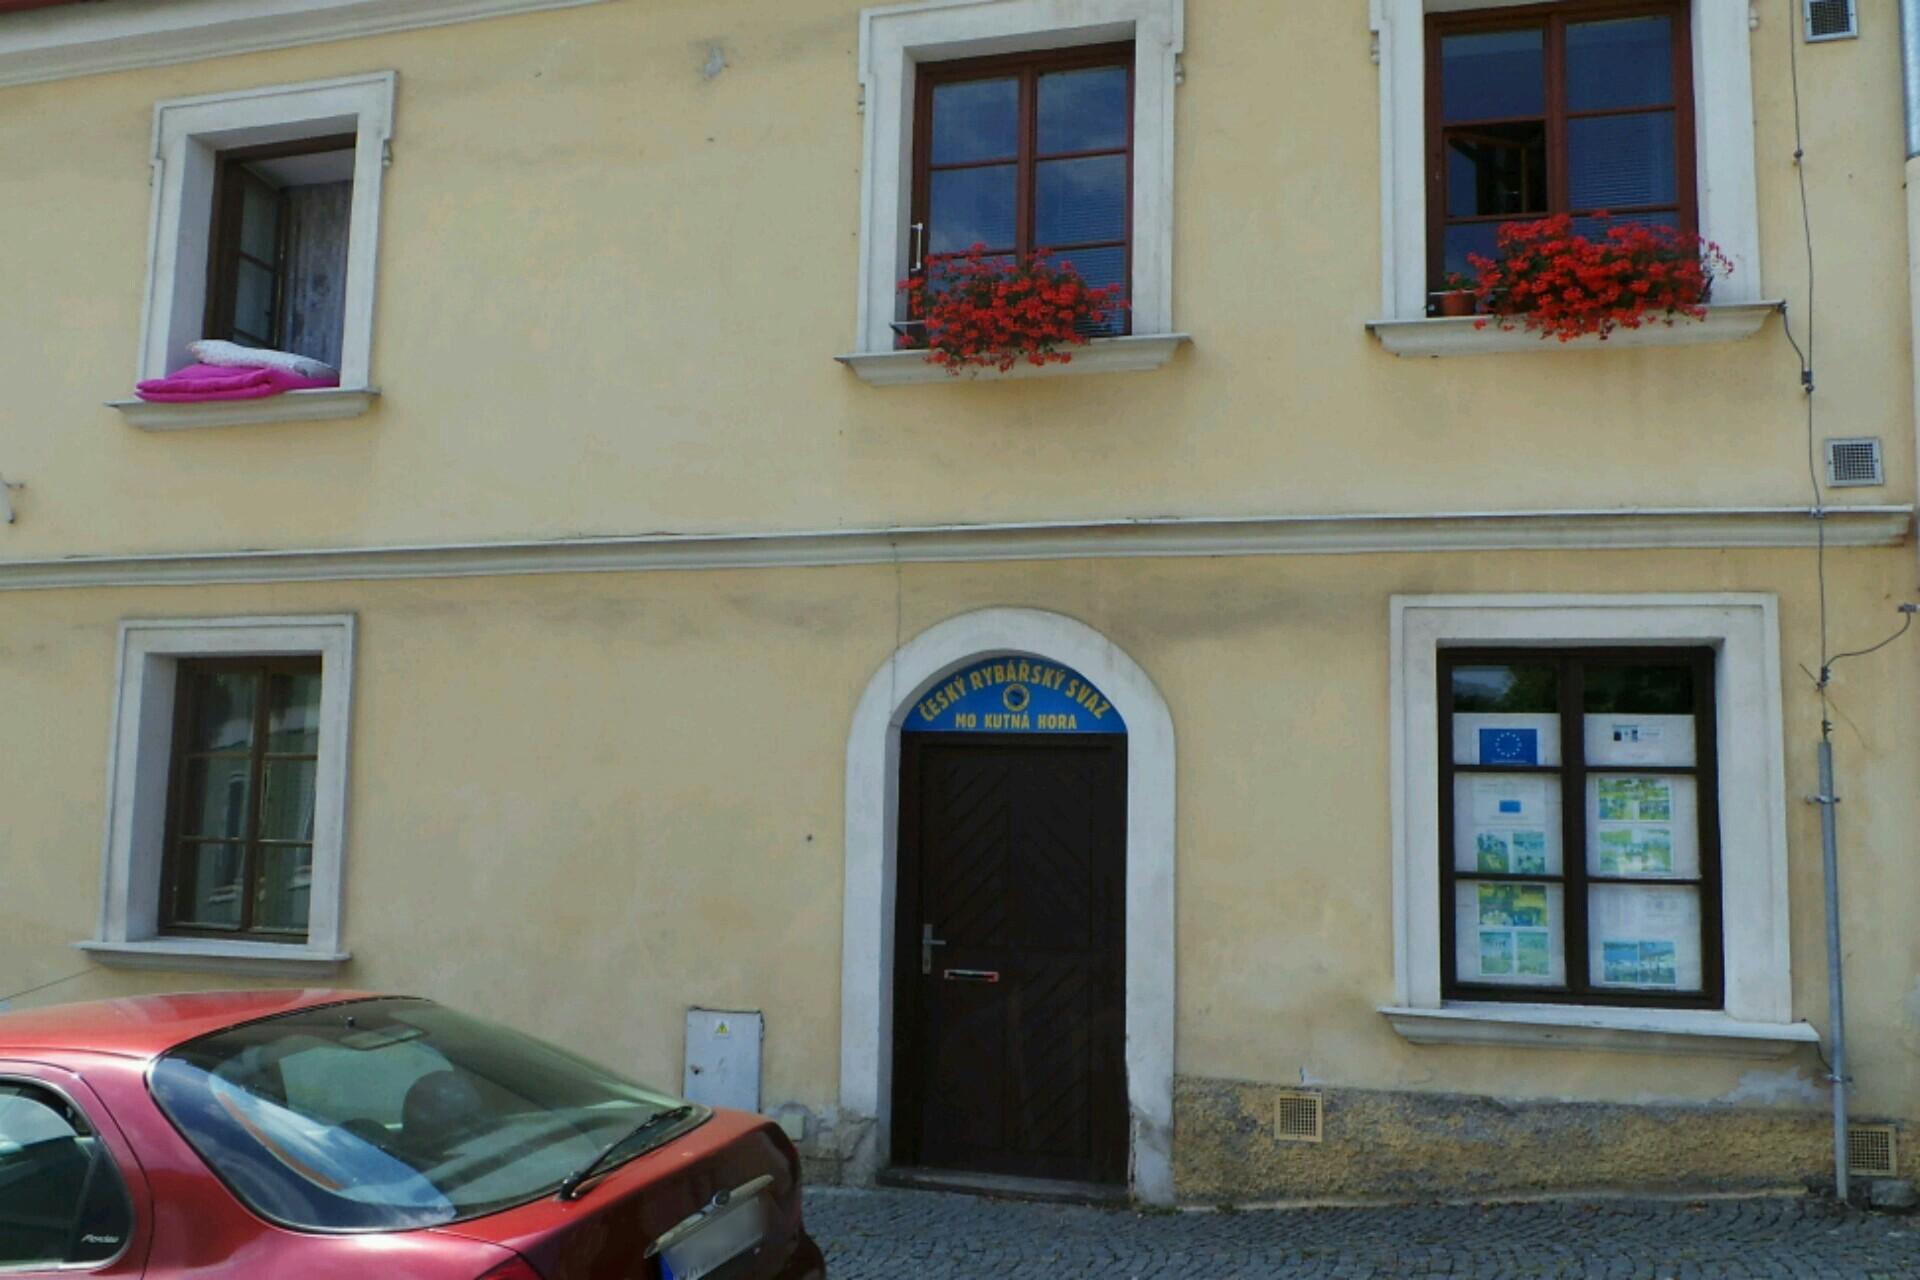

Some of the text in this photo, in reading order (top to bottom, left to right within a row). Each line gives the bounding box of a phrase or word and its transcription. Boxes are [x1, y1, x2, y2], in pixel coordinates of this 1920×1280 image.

[919, 660, 1111, 721] ČESKÝ RYBÁŘSKÝ SVAZ
[955, 711, 1077, 729] MO KUTNÁ HORA
